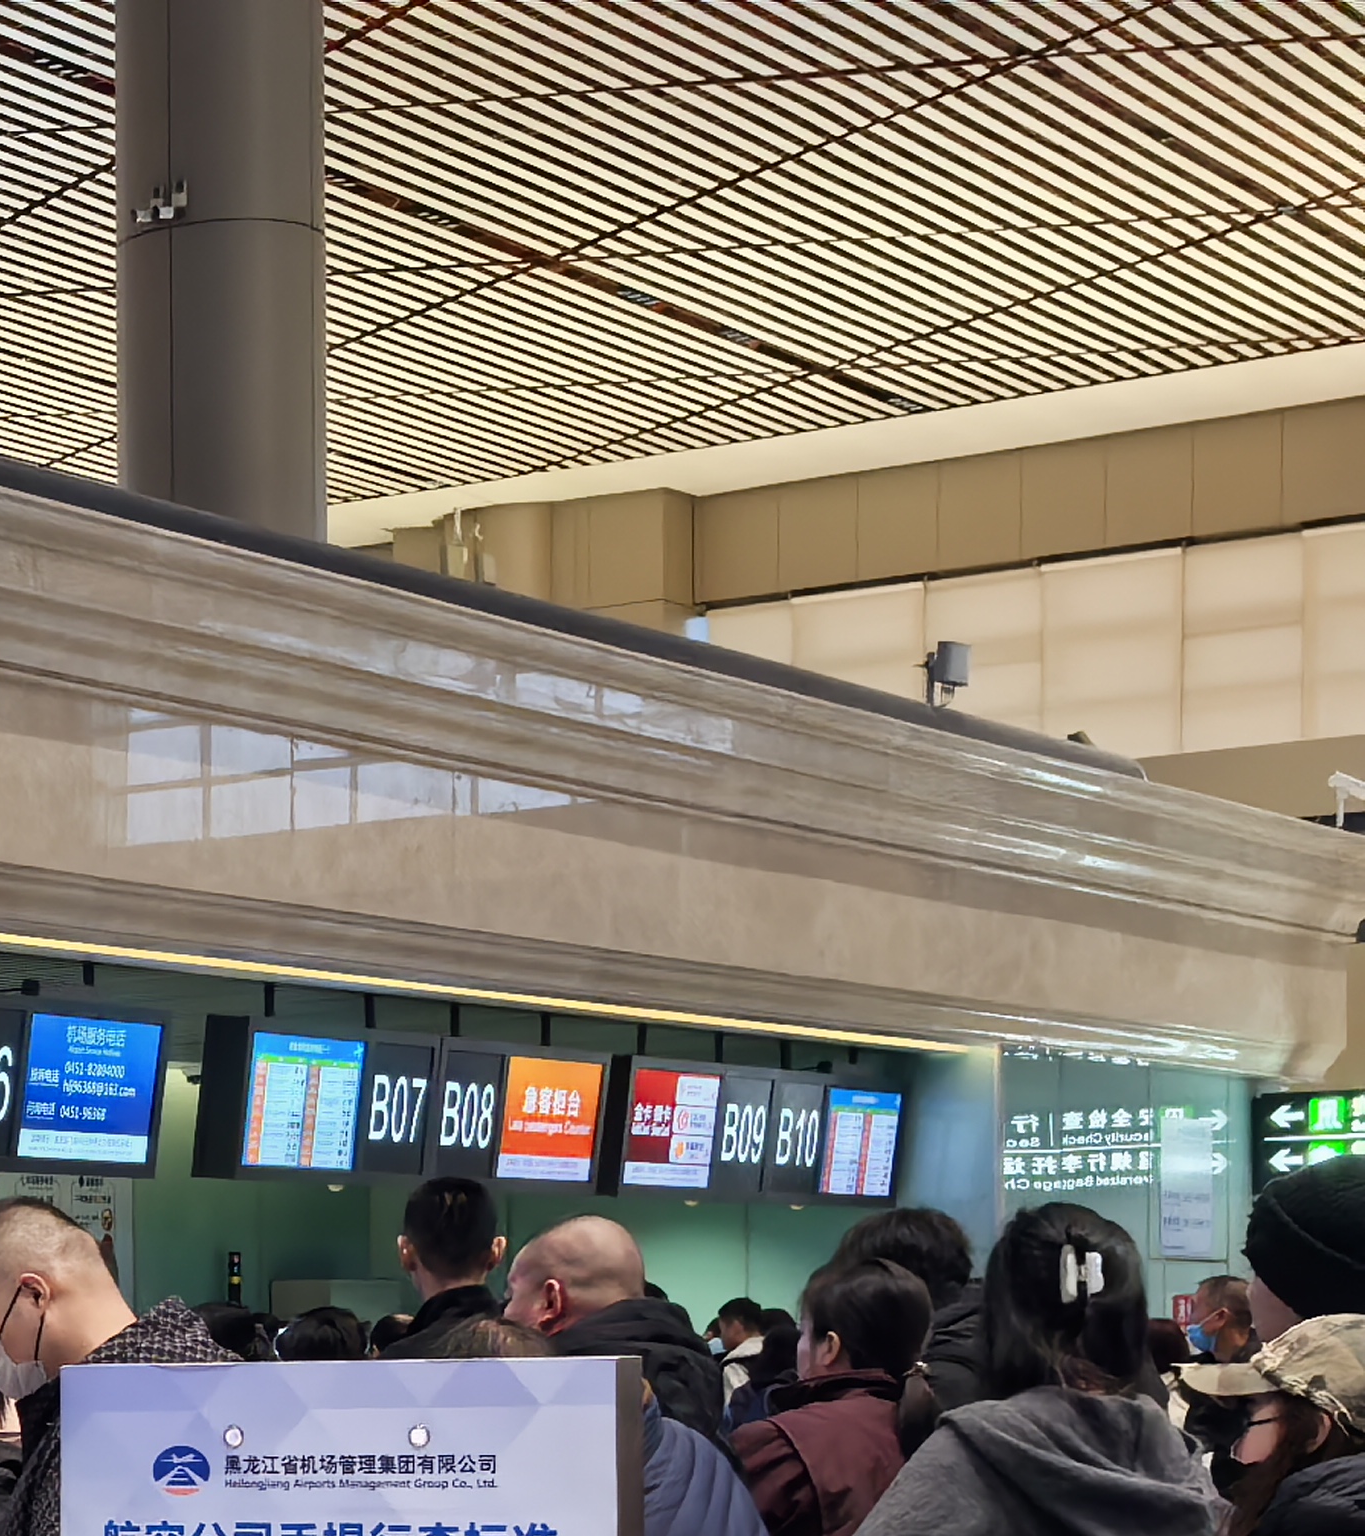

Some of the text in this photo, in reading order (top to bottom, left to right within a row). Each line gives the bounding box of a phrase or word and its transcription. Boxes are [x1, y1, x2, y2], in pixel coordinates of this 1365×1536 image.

[368, 1074, 427, 1143] B07
[440, 1081, 495, 1149] B08
[720, 1103, 766, 1164] B09
[775, 1108, 819, 1167] B10
[224, 1453, 497, 1476] 黑龙江省机场管理集团有限公司
[224, 1477, 291, 1492] Heilongjiang
[293, 1478, 337, 1491] Airports
[338, 1478, 412, 1492] Management
[413, 1477, 449, 1491] Group
